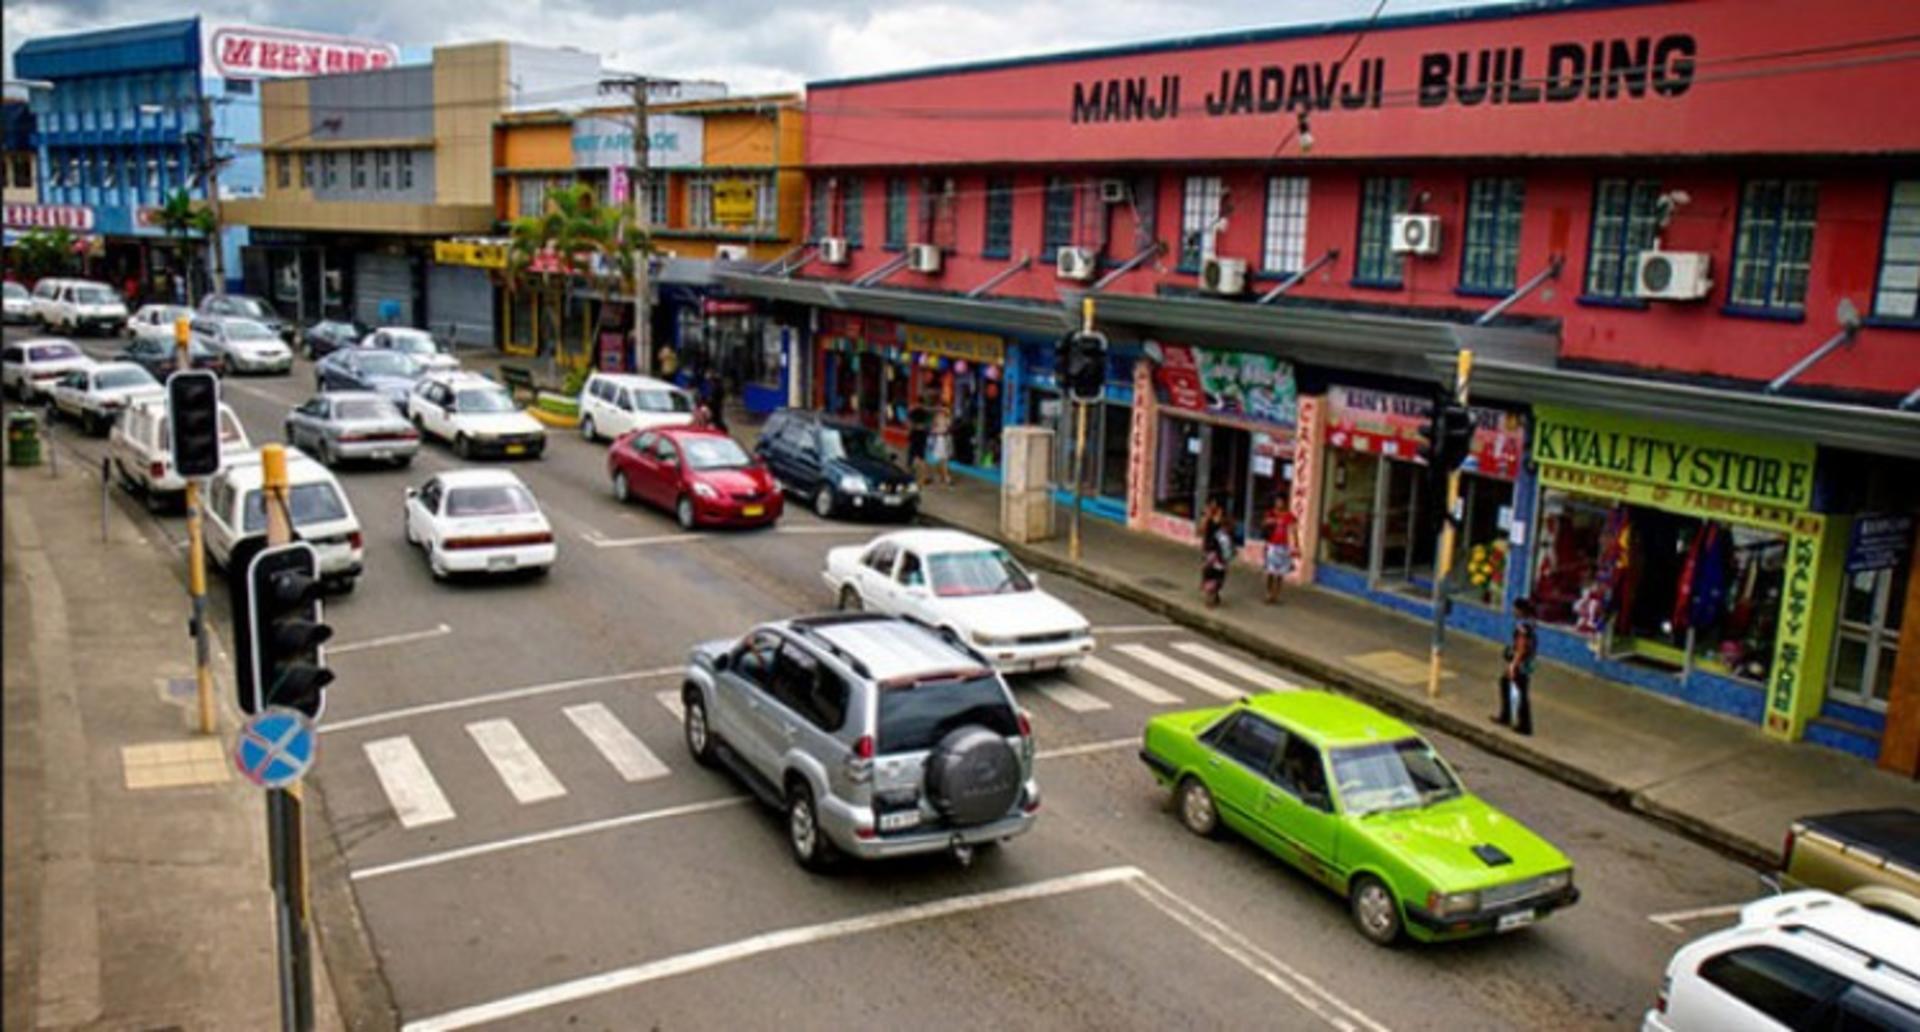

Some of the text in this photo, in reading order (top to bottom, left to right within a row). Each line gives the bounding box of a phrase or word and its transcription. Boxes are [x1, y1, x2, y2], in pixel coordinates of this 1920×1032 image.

[1072, 34, 1697, 124] MANJI JADAVJI BUILDING
[1537, 421, 1809, 502] KWALITY STORE
[1653, 484, 1672, 502] OF
